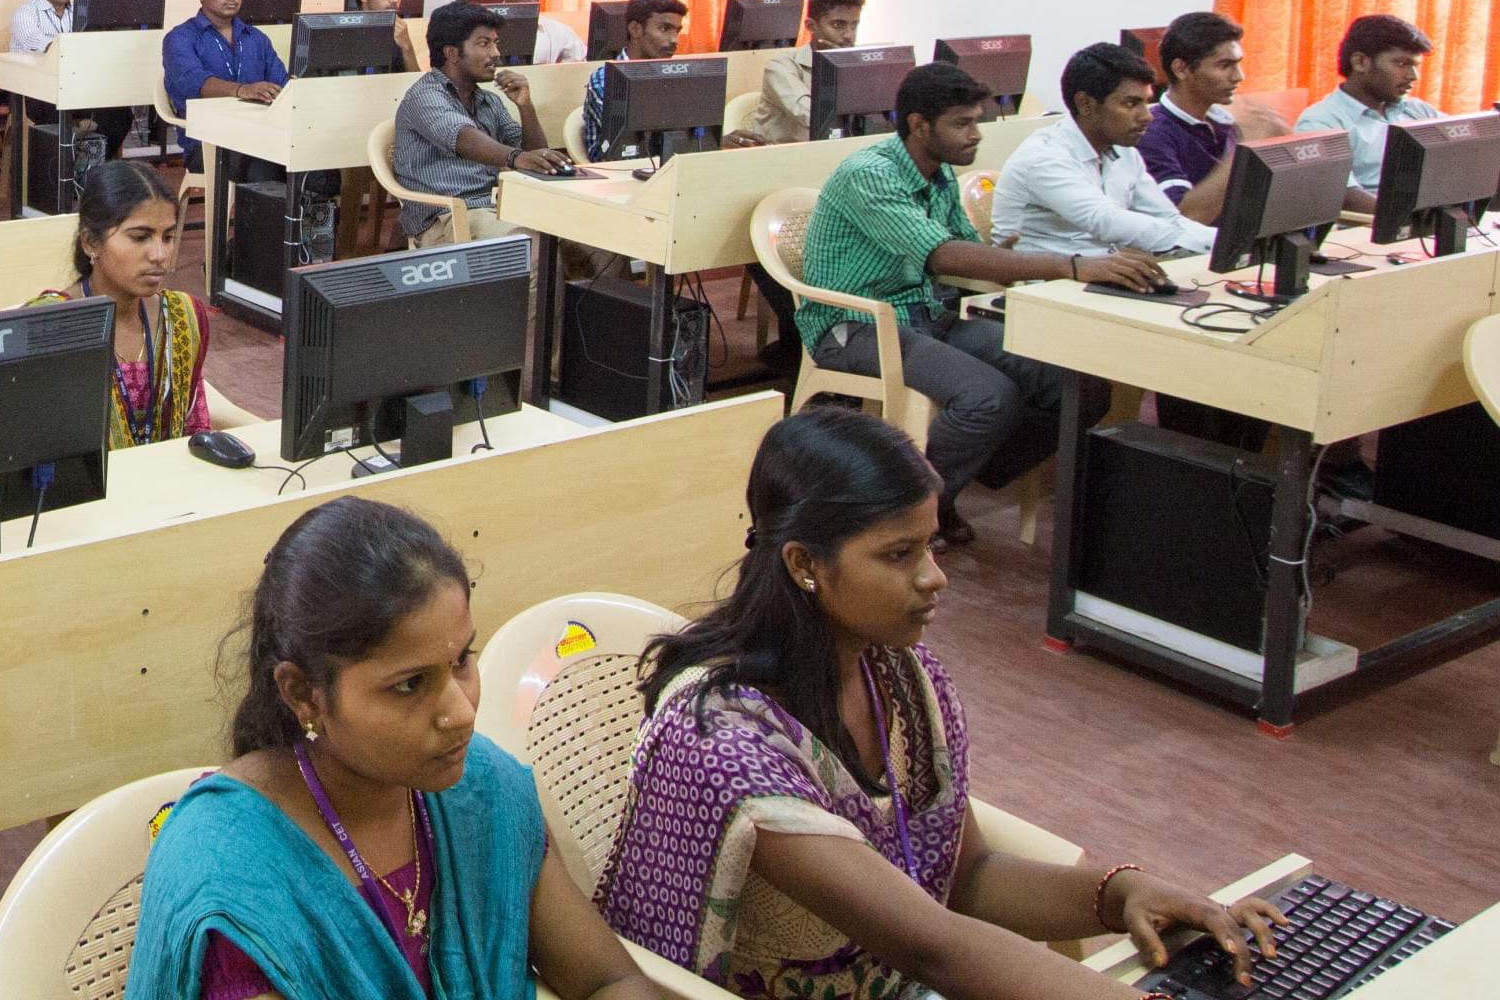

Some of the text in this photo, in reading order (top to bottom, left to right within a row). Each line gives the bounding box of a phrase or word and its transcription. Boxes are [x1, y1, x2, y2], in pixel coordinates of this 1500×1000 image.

[340, 15, 363, 24] acer
[981, 40, 1003, 49] acer
[861, 51, 884, 62] acer
[661, 64, 689, 74] acer
[401, 258, 457, 286] acer
[332, 822, 369, 879] ASIAN CET
